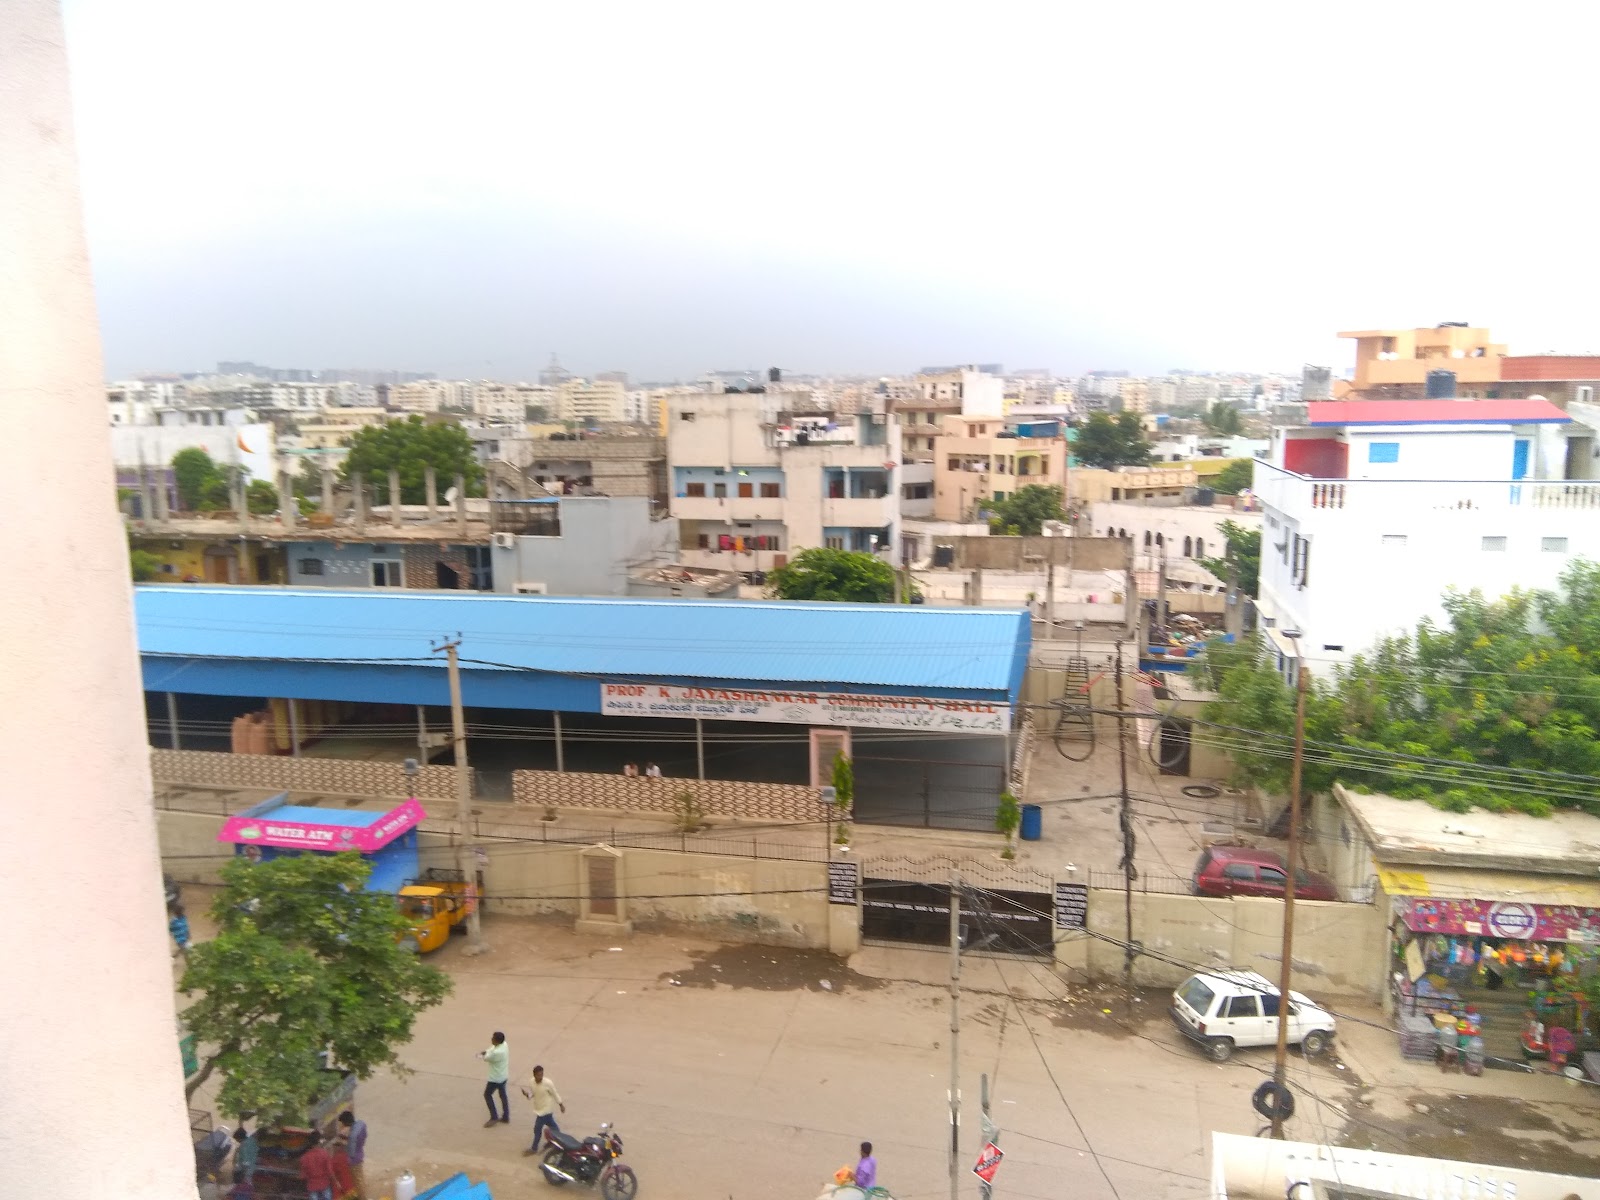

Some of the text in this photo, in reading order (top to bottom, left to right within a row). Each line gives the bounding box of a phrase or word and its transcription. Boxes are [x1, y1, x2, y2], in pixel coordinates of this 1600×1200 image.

[682, 687, 819, 705] JAYASHANKAR
[827, 694, 936, 711] COMMUNITY
[946, 700, 996, 714] HALL
[265, 826, 306, 838] WATER
[306, 830, 334, 840] ATM
